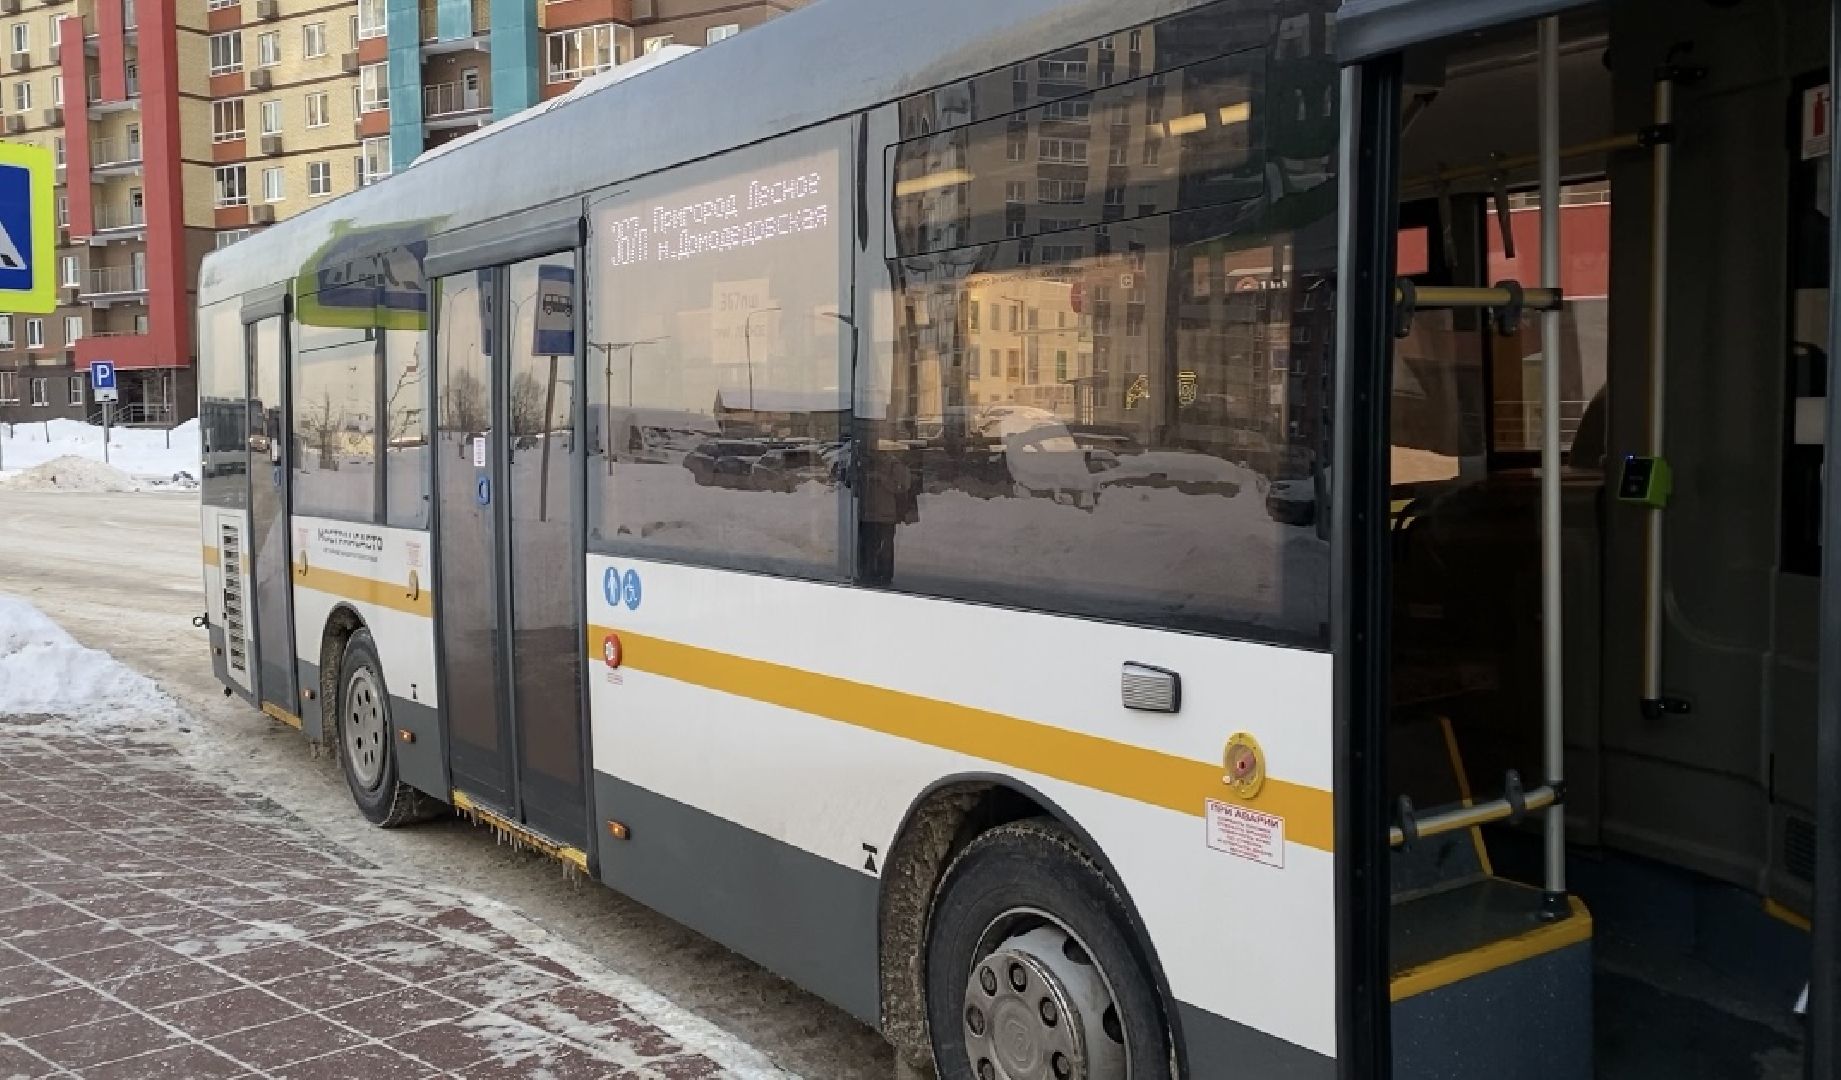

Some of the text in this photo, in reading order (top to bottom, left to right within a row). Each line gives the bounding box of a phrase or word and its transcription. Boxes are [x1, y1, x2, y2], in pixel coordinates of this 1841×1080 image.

[653, 172, 821, 234] Пригород Лесное
[96, 364, 110, 386] P
[1210, 803, 1279, 829] ПРИ АВАРИИ
